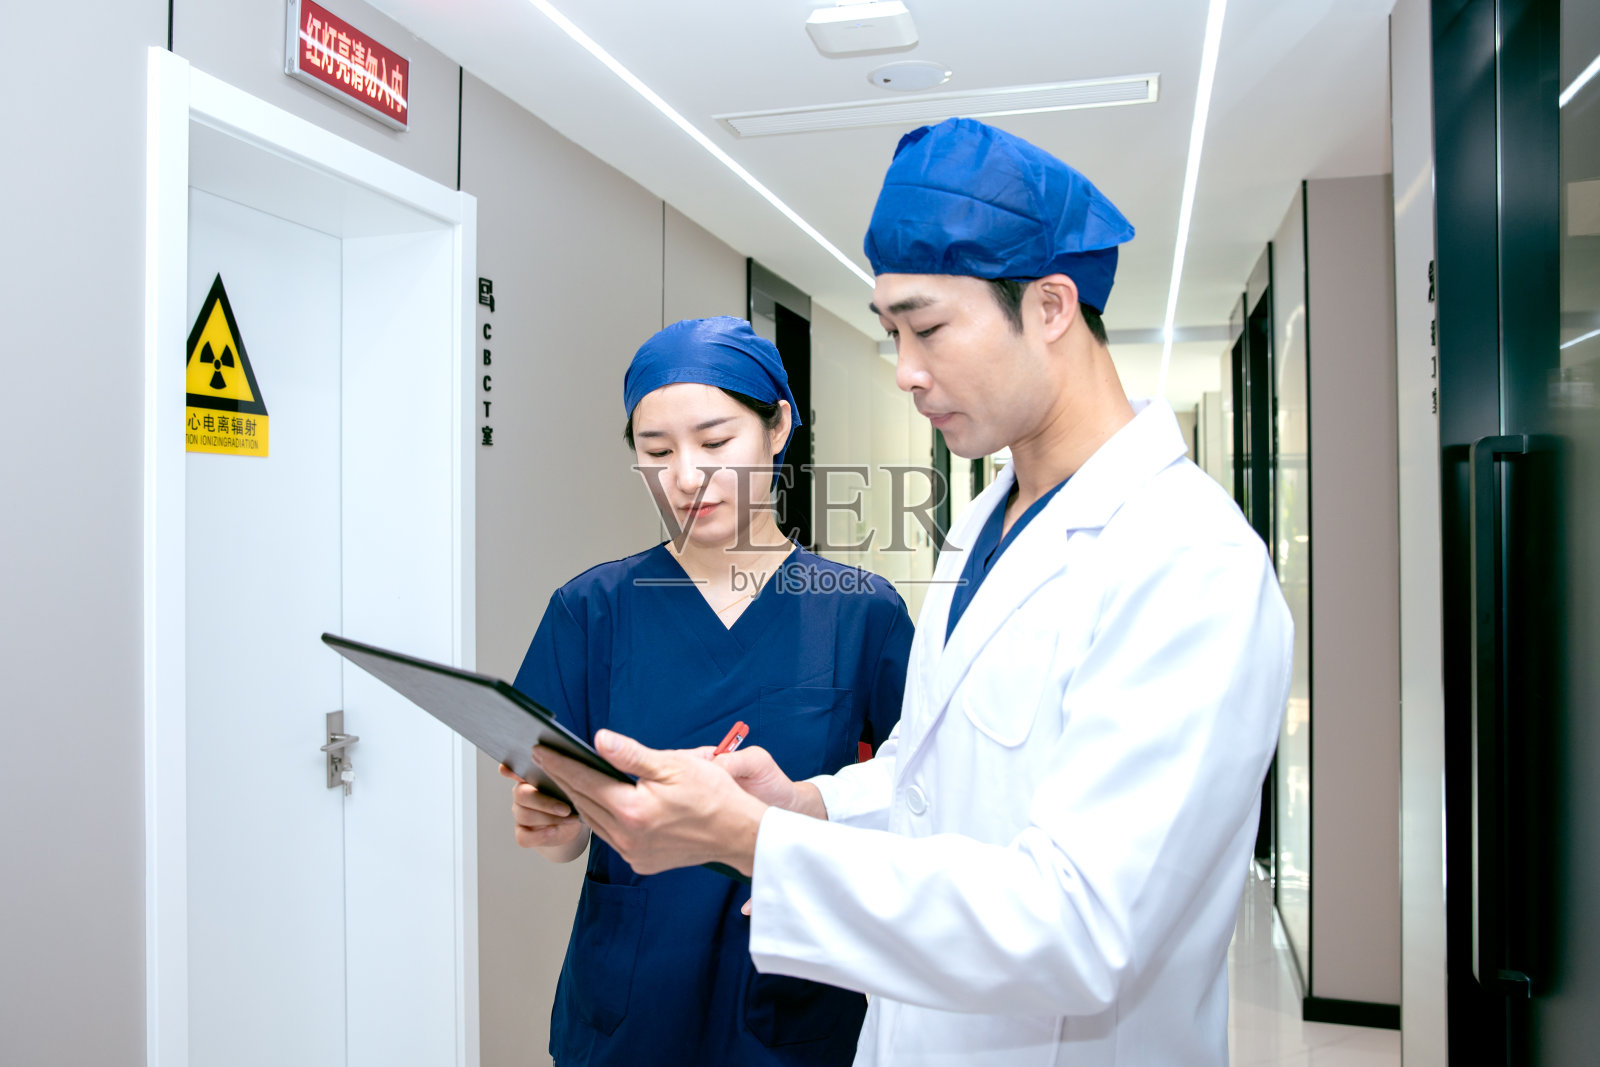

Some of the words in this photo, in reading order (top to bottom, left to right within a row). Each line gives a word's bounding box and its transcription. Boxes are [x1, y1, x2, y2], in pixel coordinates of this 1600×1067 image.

[305, 12, 403, 113] 红灯亮请勿入内
[187, 413, 257, 437] 心电离辐射
